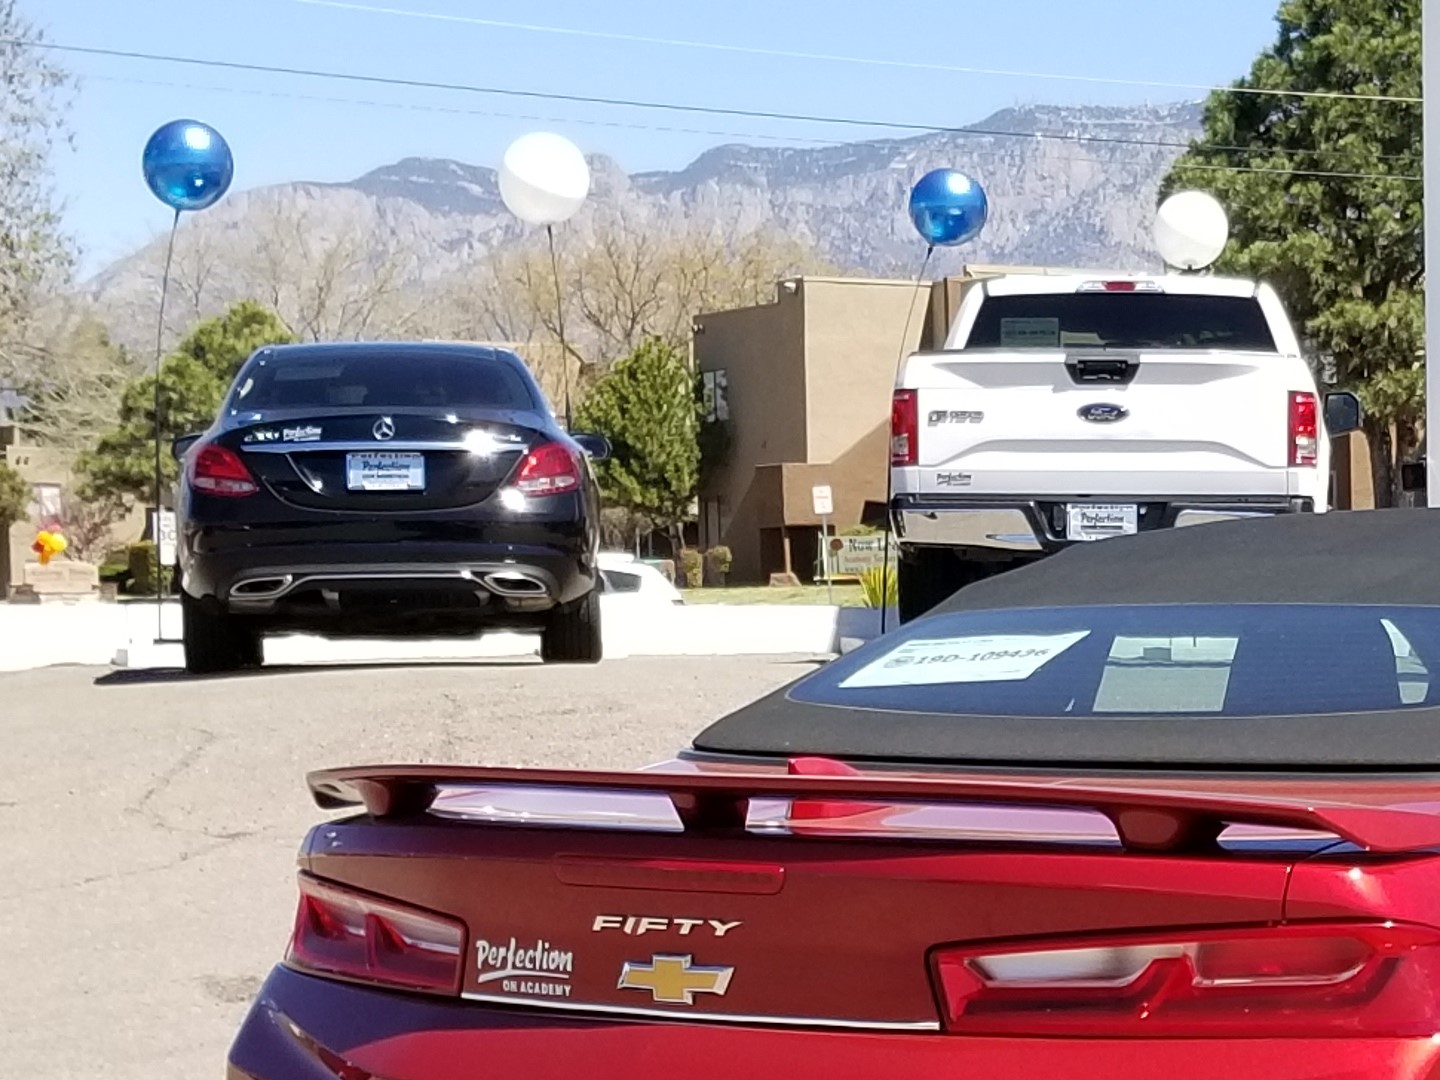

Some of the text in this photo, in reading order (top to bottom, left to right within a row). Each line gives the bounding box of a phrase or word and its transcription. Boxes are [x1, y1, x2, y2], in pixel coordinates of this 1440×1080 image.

[591, 915, 744, 937] FIFTY
[476, 937, 573, 972] Perfection
[502, 980, 571, 997] ON ACADEMY
